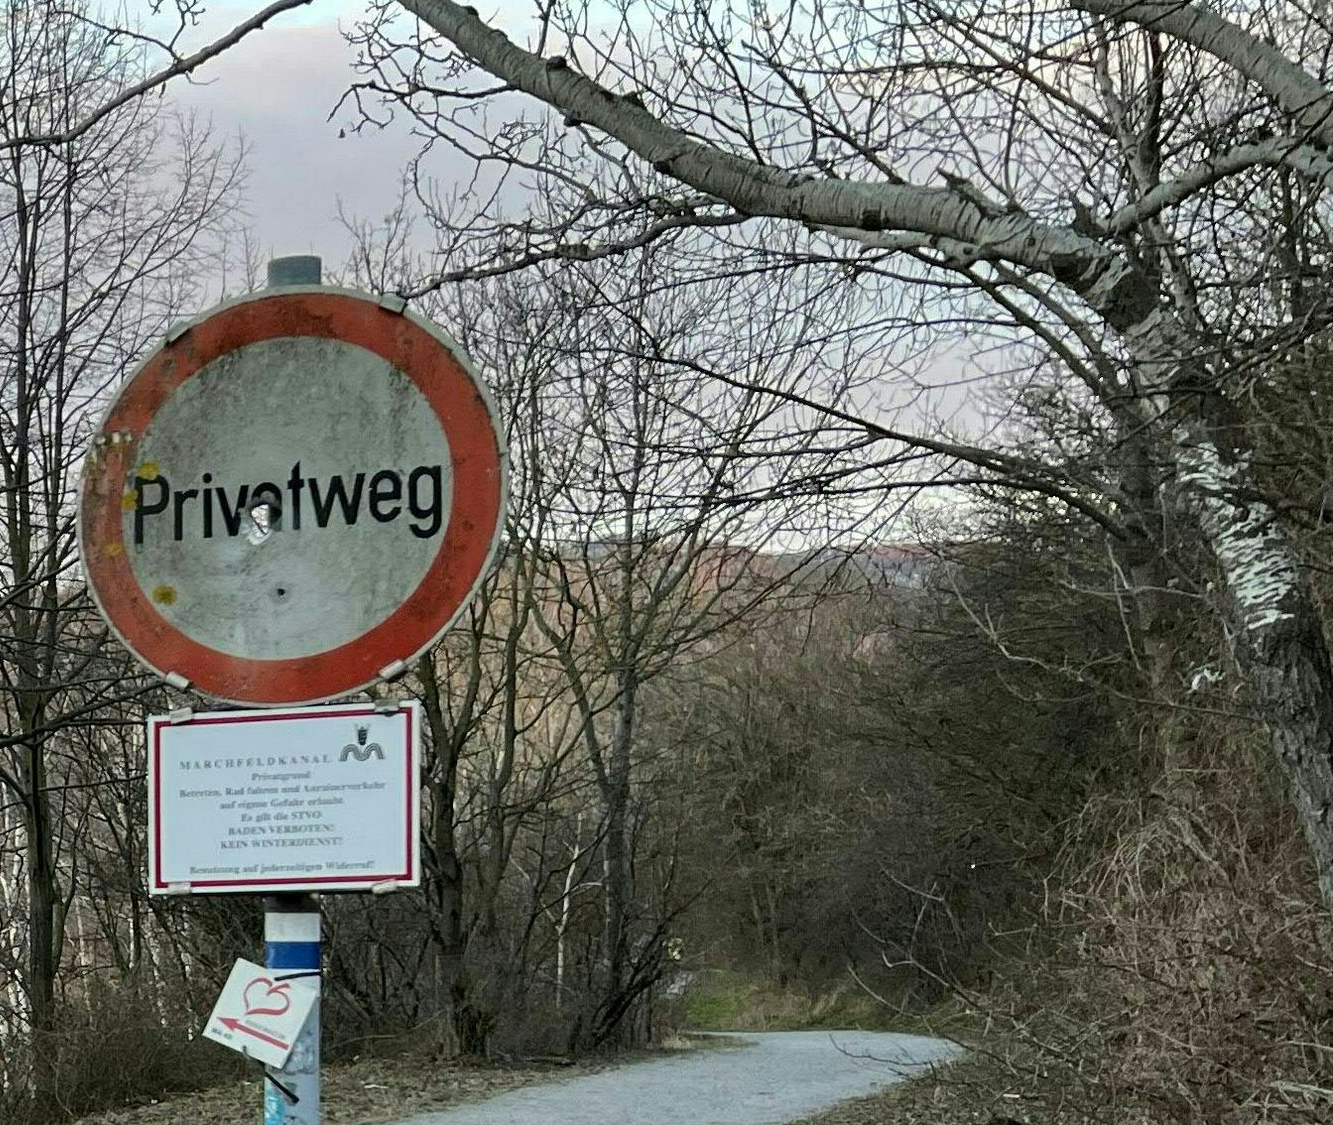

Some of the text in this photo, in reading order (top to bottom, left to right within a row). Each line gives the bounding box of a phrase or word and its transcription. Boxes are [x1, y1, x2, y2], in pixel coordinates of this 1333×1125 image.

[134, 461, 442, 544] Privatweg
[179, 754, 331, 770] MARCHFELDKANAL
[251, 770, 310, 781] Privatgrund
[225, 787, 245, 796] Rad
[282, 785, 300, 793] und
[220, 800, 237, 809] auf
[270, 798, 304, 807] Gefahr
[241, 813, 253, 822] Es
[255, 812, 271, 823] gilt
[273, 811, 289, 821] die
[228, 826, 266, 836] BADEN
[221, 839, 248, 849] KEIN
[243, 864, 259, 873] auf
